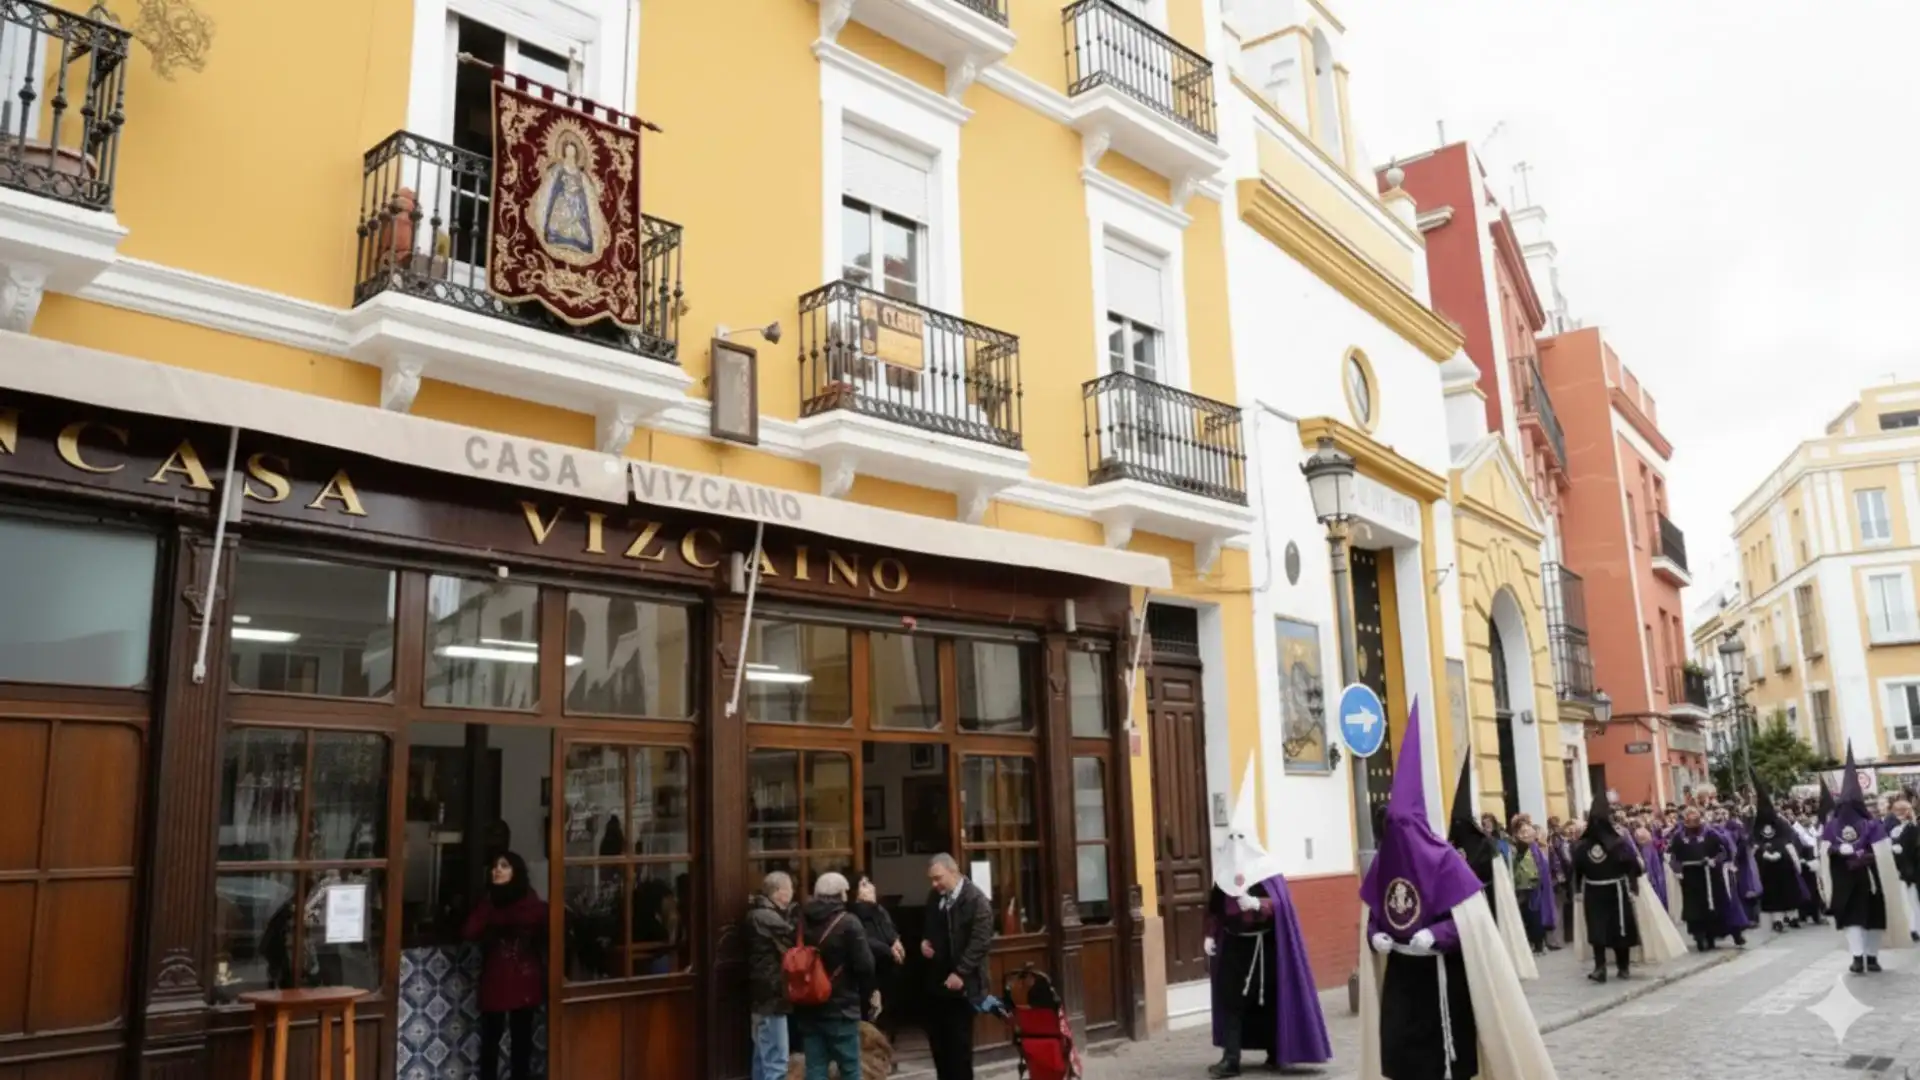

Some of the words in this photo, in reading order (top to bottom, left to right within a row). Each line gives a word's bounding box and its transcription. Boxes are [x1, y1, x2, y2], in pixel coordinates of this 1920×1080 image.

[57, 420, 369, 517] CASA
[520, 501, 909, 593] VIZCAINO
[464, 435, 581, 488] CASA
[633, 464, 802, 521] VIZCAINO
